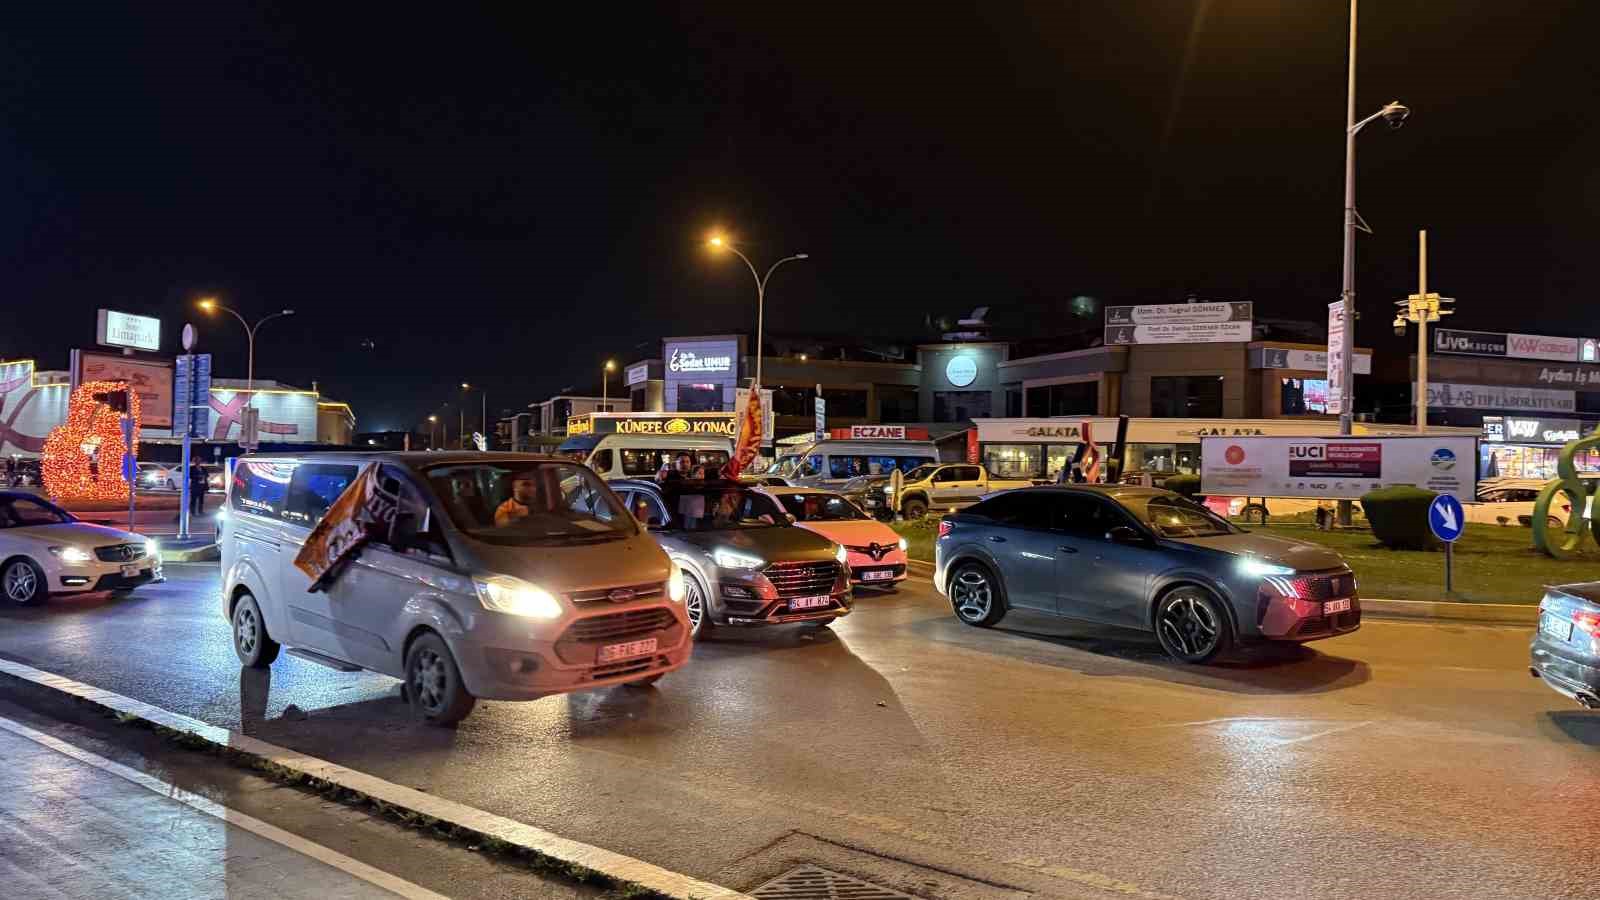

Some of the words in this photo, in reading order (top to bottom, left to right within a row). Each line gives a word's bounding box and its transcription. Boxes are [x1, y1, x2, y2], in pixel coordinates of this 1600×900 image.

[616, 418, 662, 434] KÜNEFE
[693, 418, 736, 434] KONAĞ
[853, 427, 902, 438] ECZANE
[1028, 428, 1081, 437] GALATA
[1295, 446, 1323, 458] UCI
